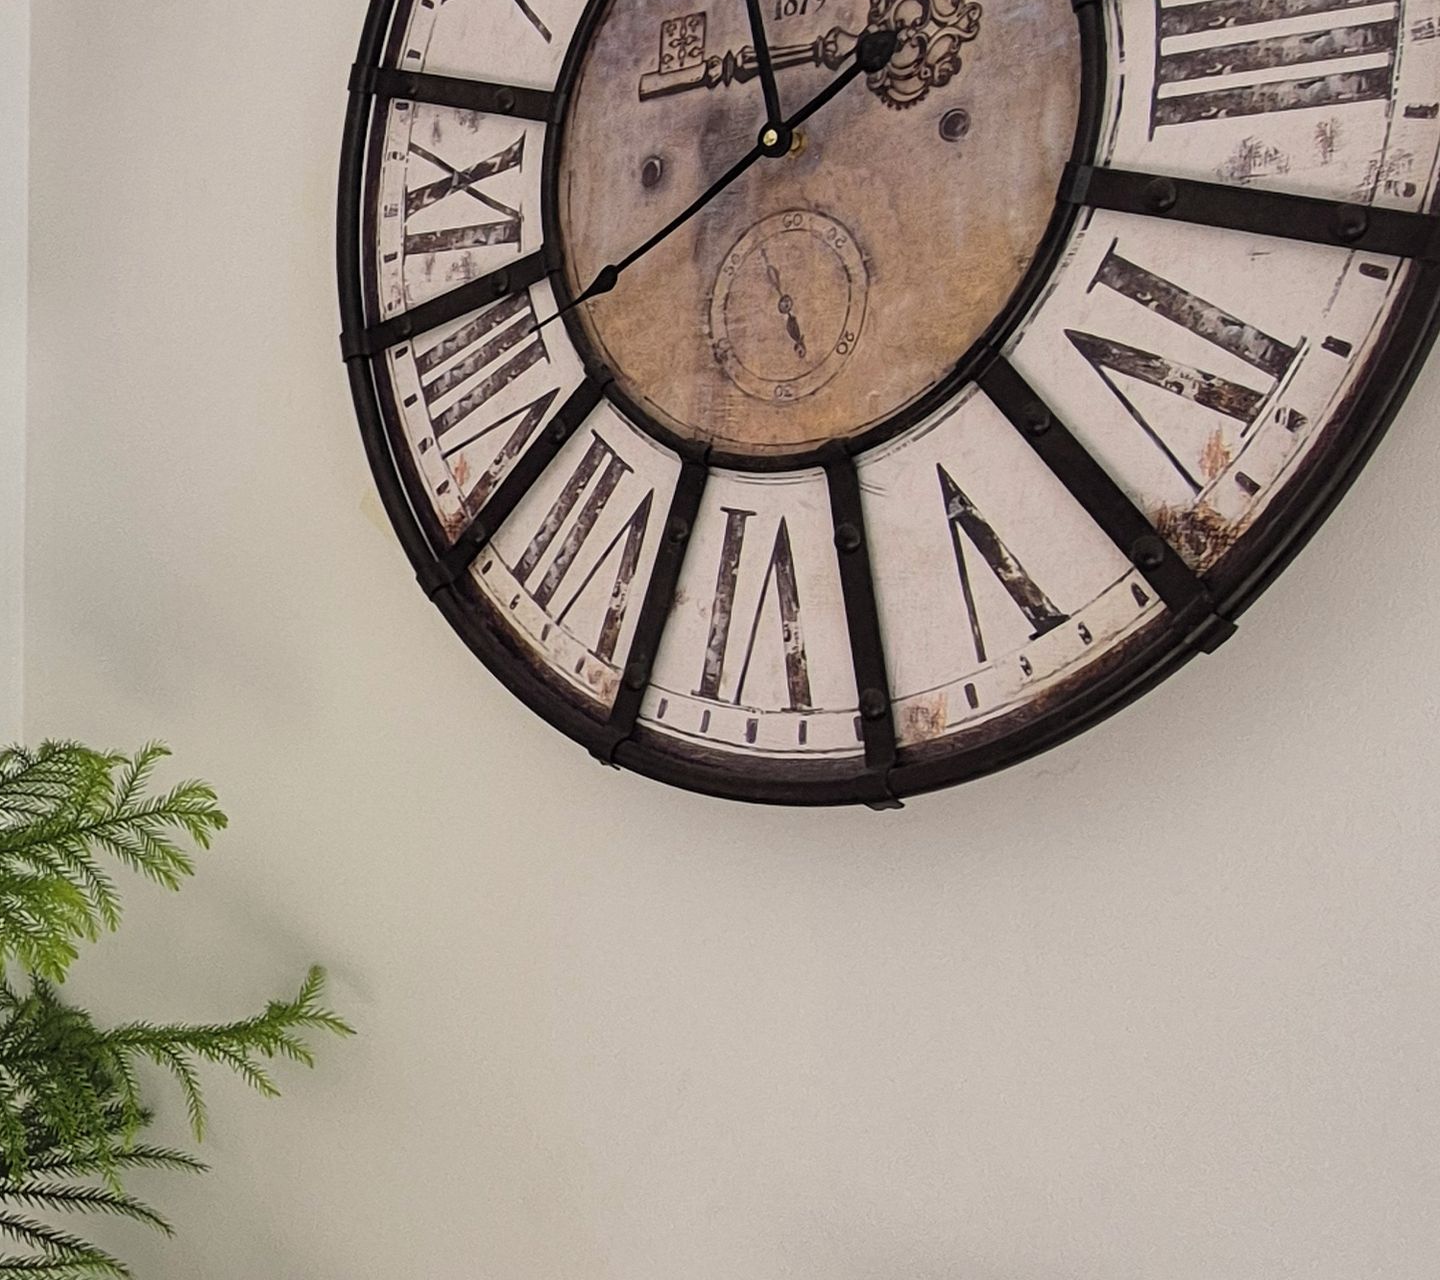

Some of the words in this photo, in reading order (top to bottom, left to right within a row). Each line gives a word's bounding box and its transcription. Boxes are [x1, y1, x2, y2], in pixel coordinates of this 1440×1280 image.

[404, 129, 526, 257] IX
[415, 290, 560, 519] VIII
[1064, 237, 1308, 496] IV
[511, 429, 654, 665] VII
[691, 506, 824, 712] VI
[937, 462, 1071, 662] V
